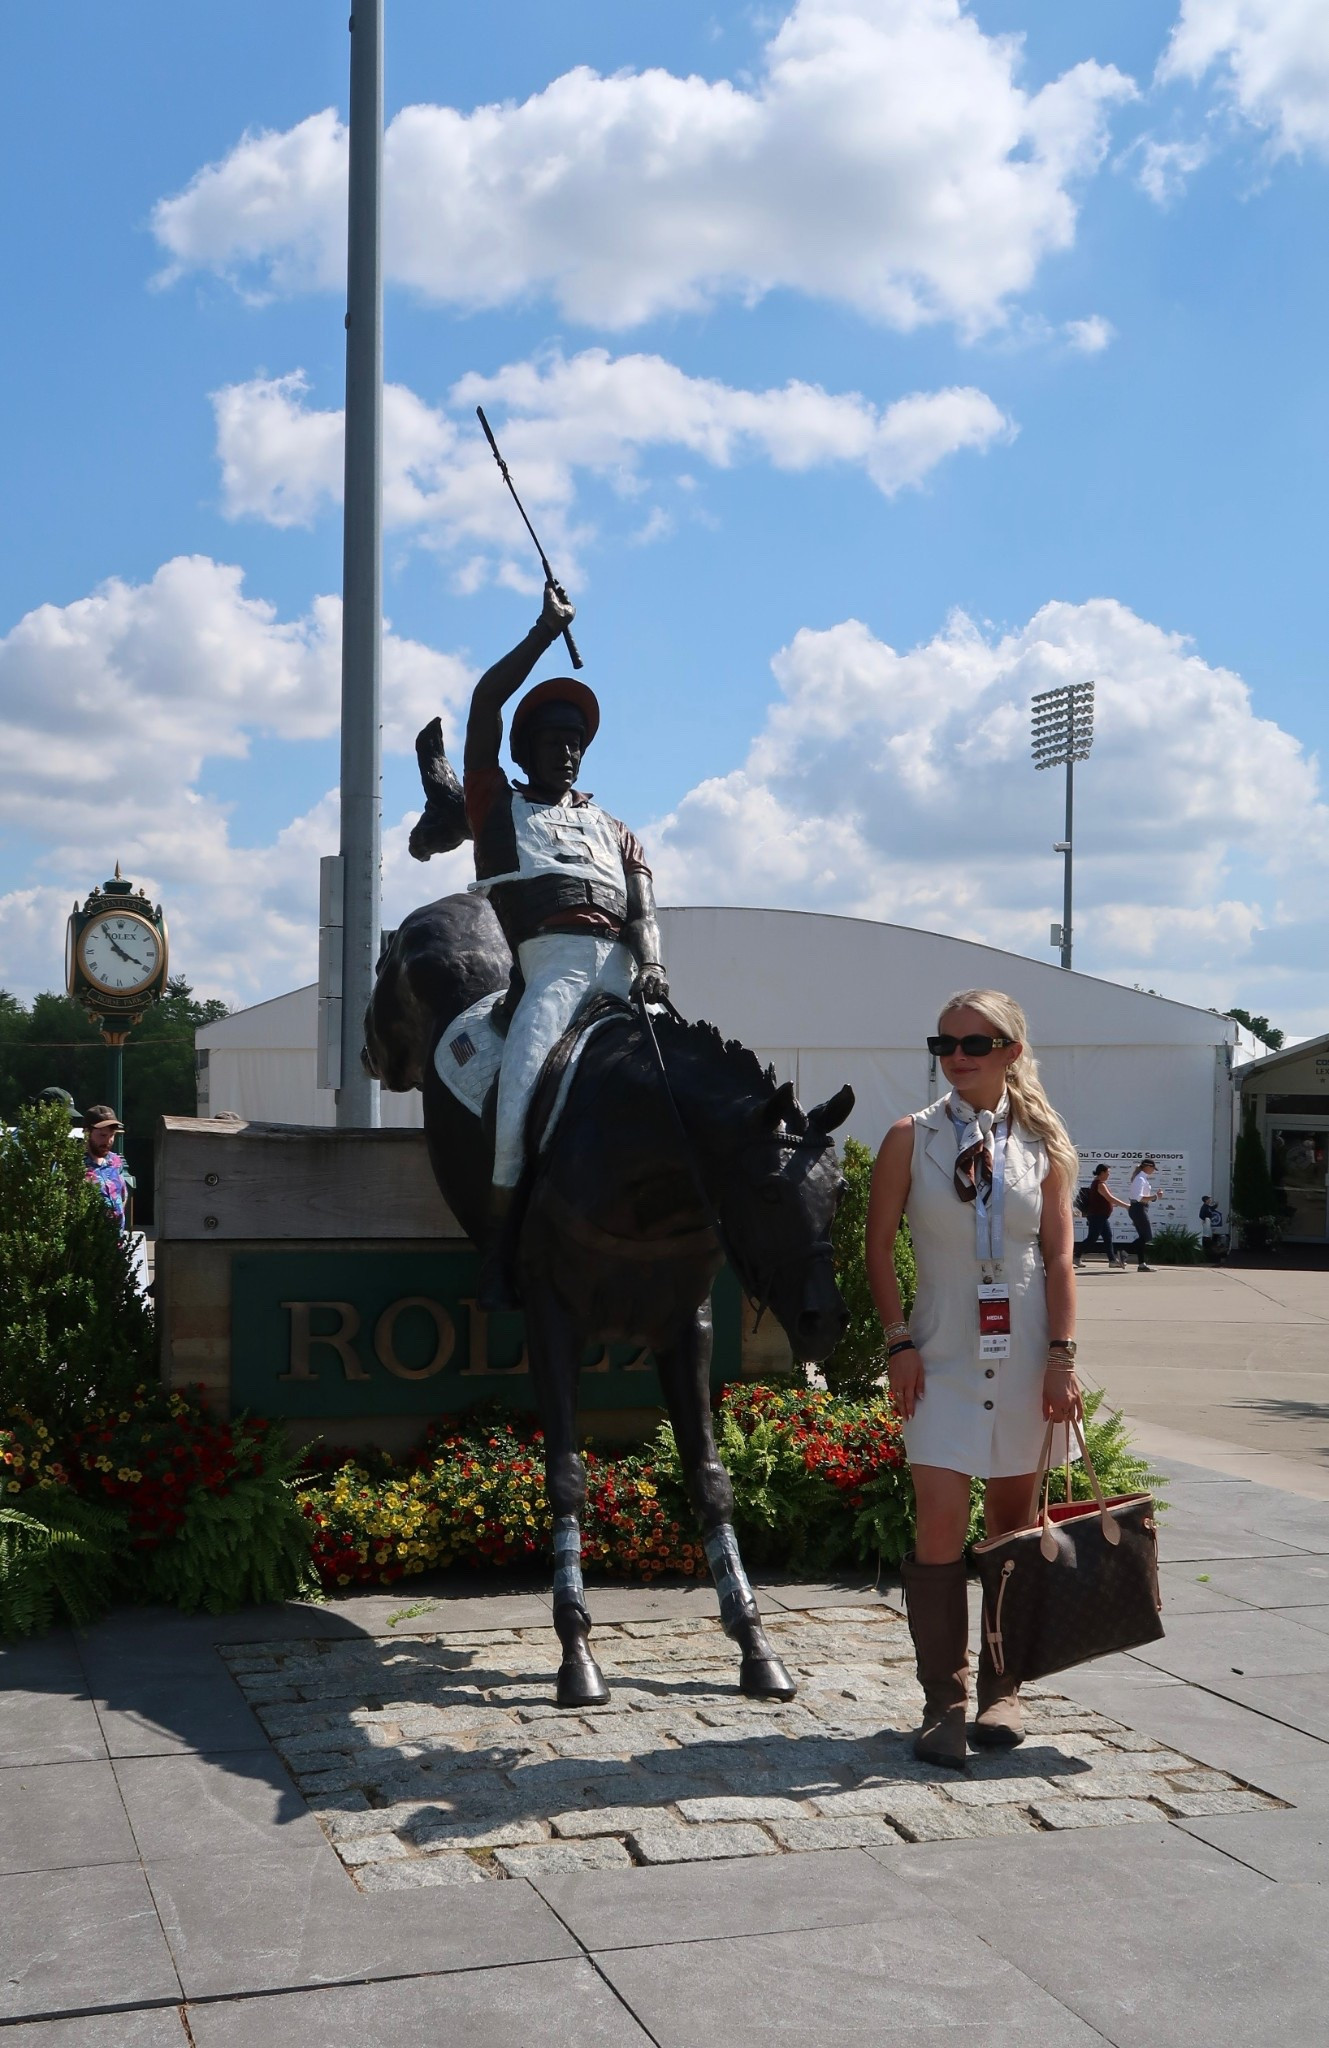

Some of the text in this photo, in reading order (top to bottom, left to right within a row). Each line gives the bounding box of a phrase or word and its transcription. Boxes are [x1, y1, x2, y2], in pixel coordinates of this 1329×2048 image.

[531, 805, 604, 825] ROLEX
[545, 820, 595, 865] 5
[279, 1296, 653, 1381] ROL
